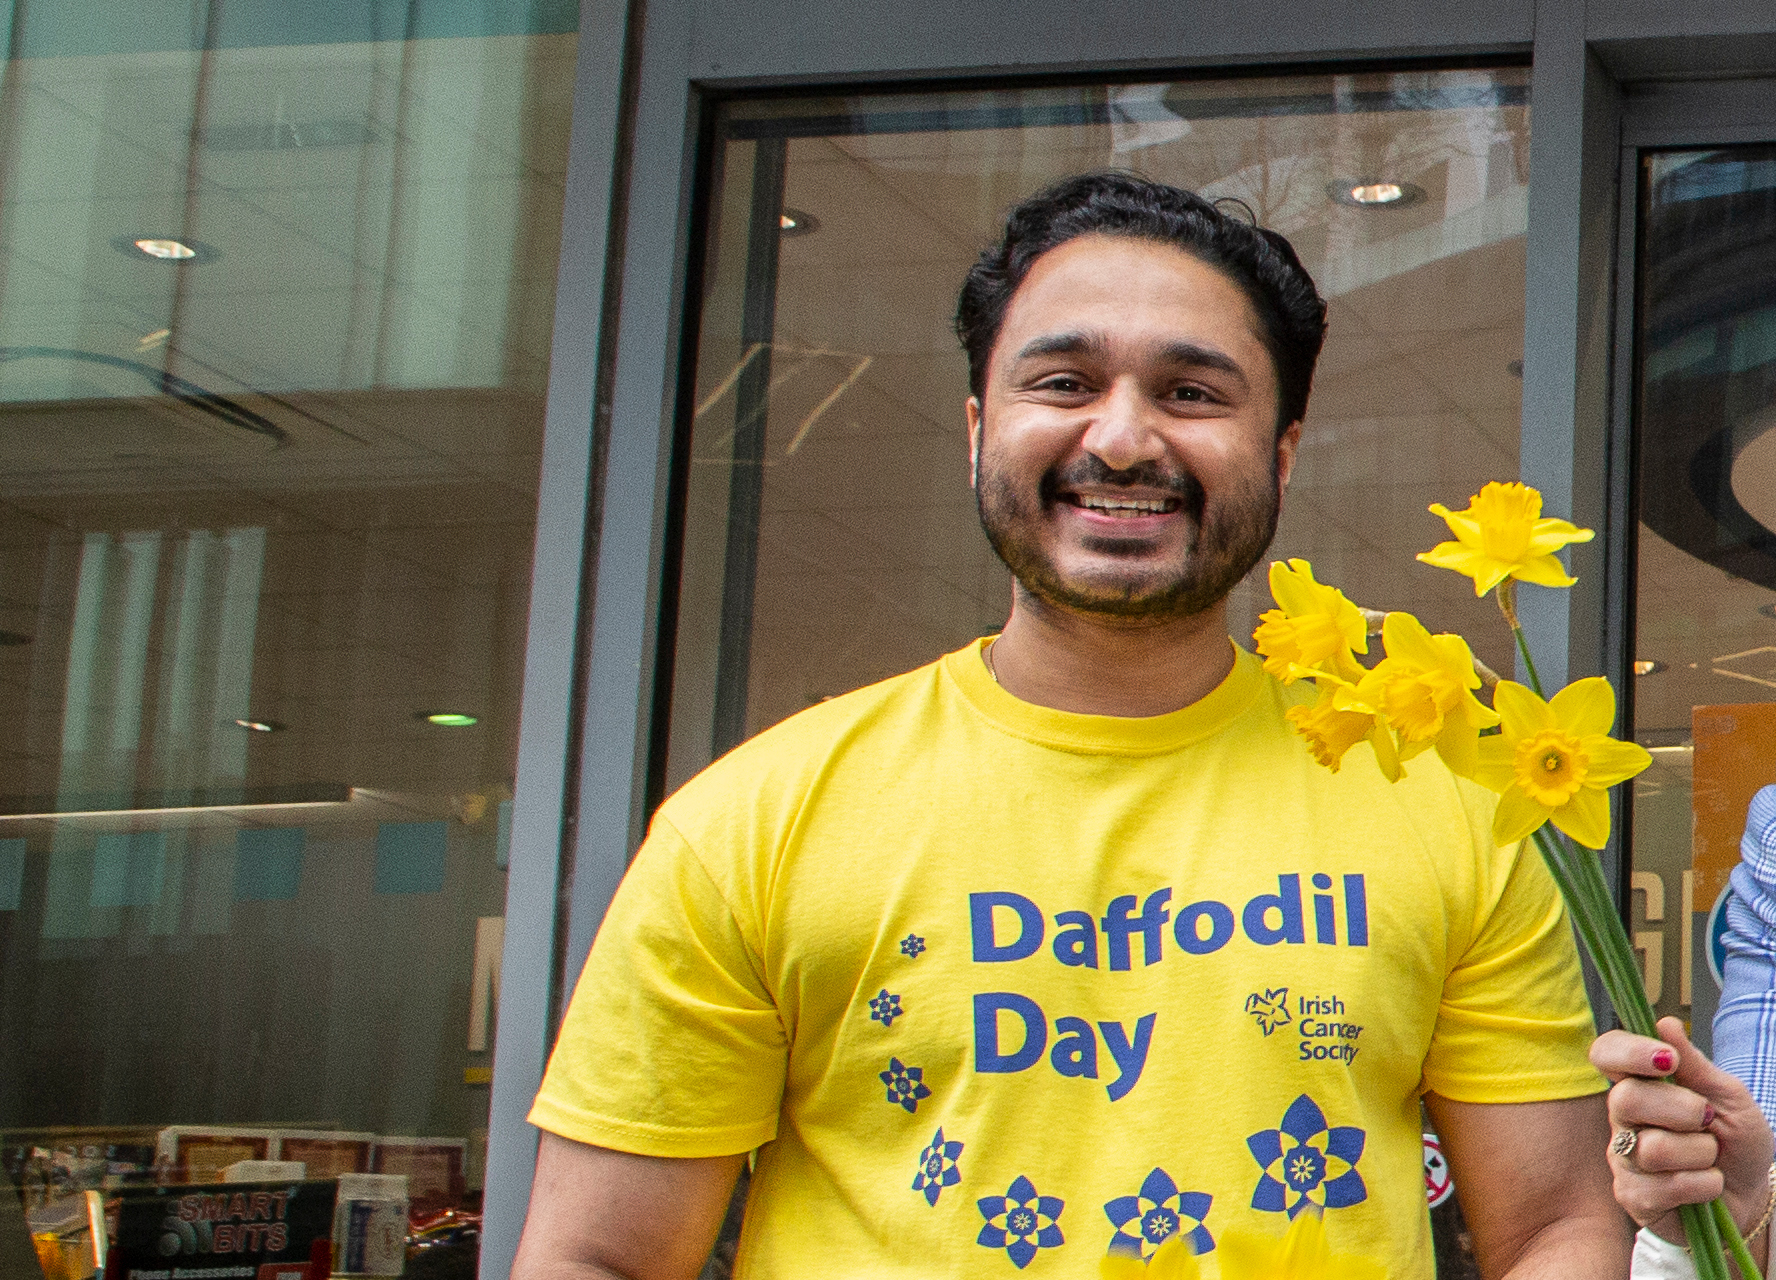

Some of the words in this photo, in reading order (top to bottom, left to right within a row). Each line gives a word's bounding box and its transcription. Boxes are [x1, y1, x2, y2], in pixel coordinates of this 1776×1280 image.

[968, 873, 1369, 972] Daffodil
[1299, 994, 1345, 1015] Irish
[1299, 1018, 1364, 1040] Cancer
[972, 991, 1157, 1102] Day
[178, 1191, 290, 1222] SMART
[212, 1222, 288, 1254] BITS
